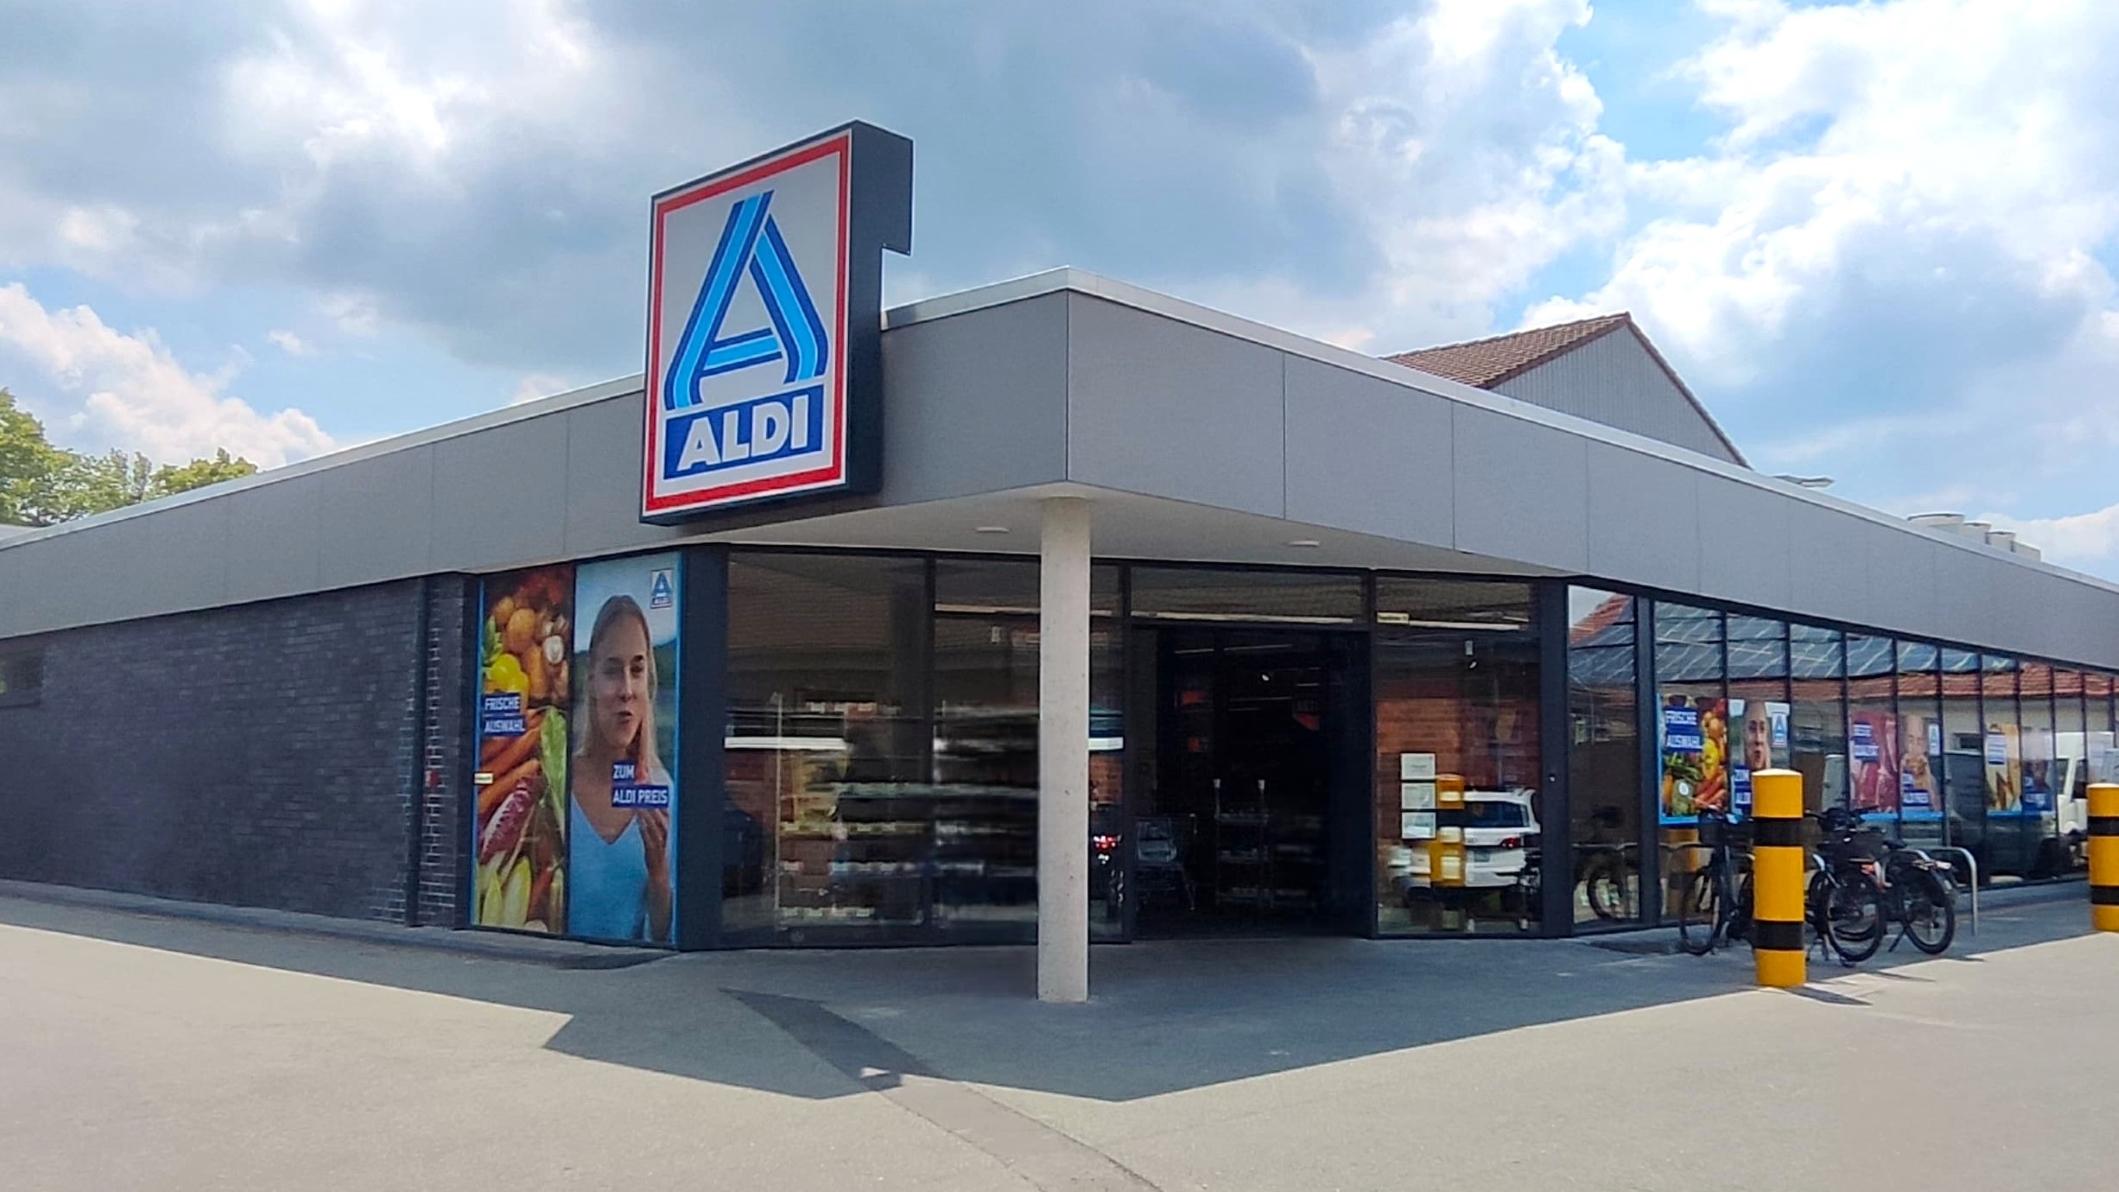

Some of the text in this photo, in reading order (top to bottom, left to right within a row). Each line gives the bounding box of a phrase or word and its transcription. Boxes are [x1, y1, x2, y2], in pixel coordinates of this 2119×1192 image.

[664, 189, 829, 412] A
[676, 394, 809, 472] ALDI
[485, 697, 520, 710] FRISCHE
[484, 719, 525, 732] AUSWAHL
[613, 764, 635, 779] ZUM
[613, 789, 668, 803] ALDI PREIS
